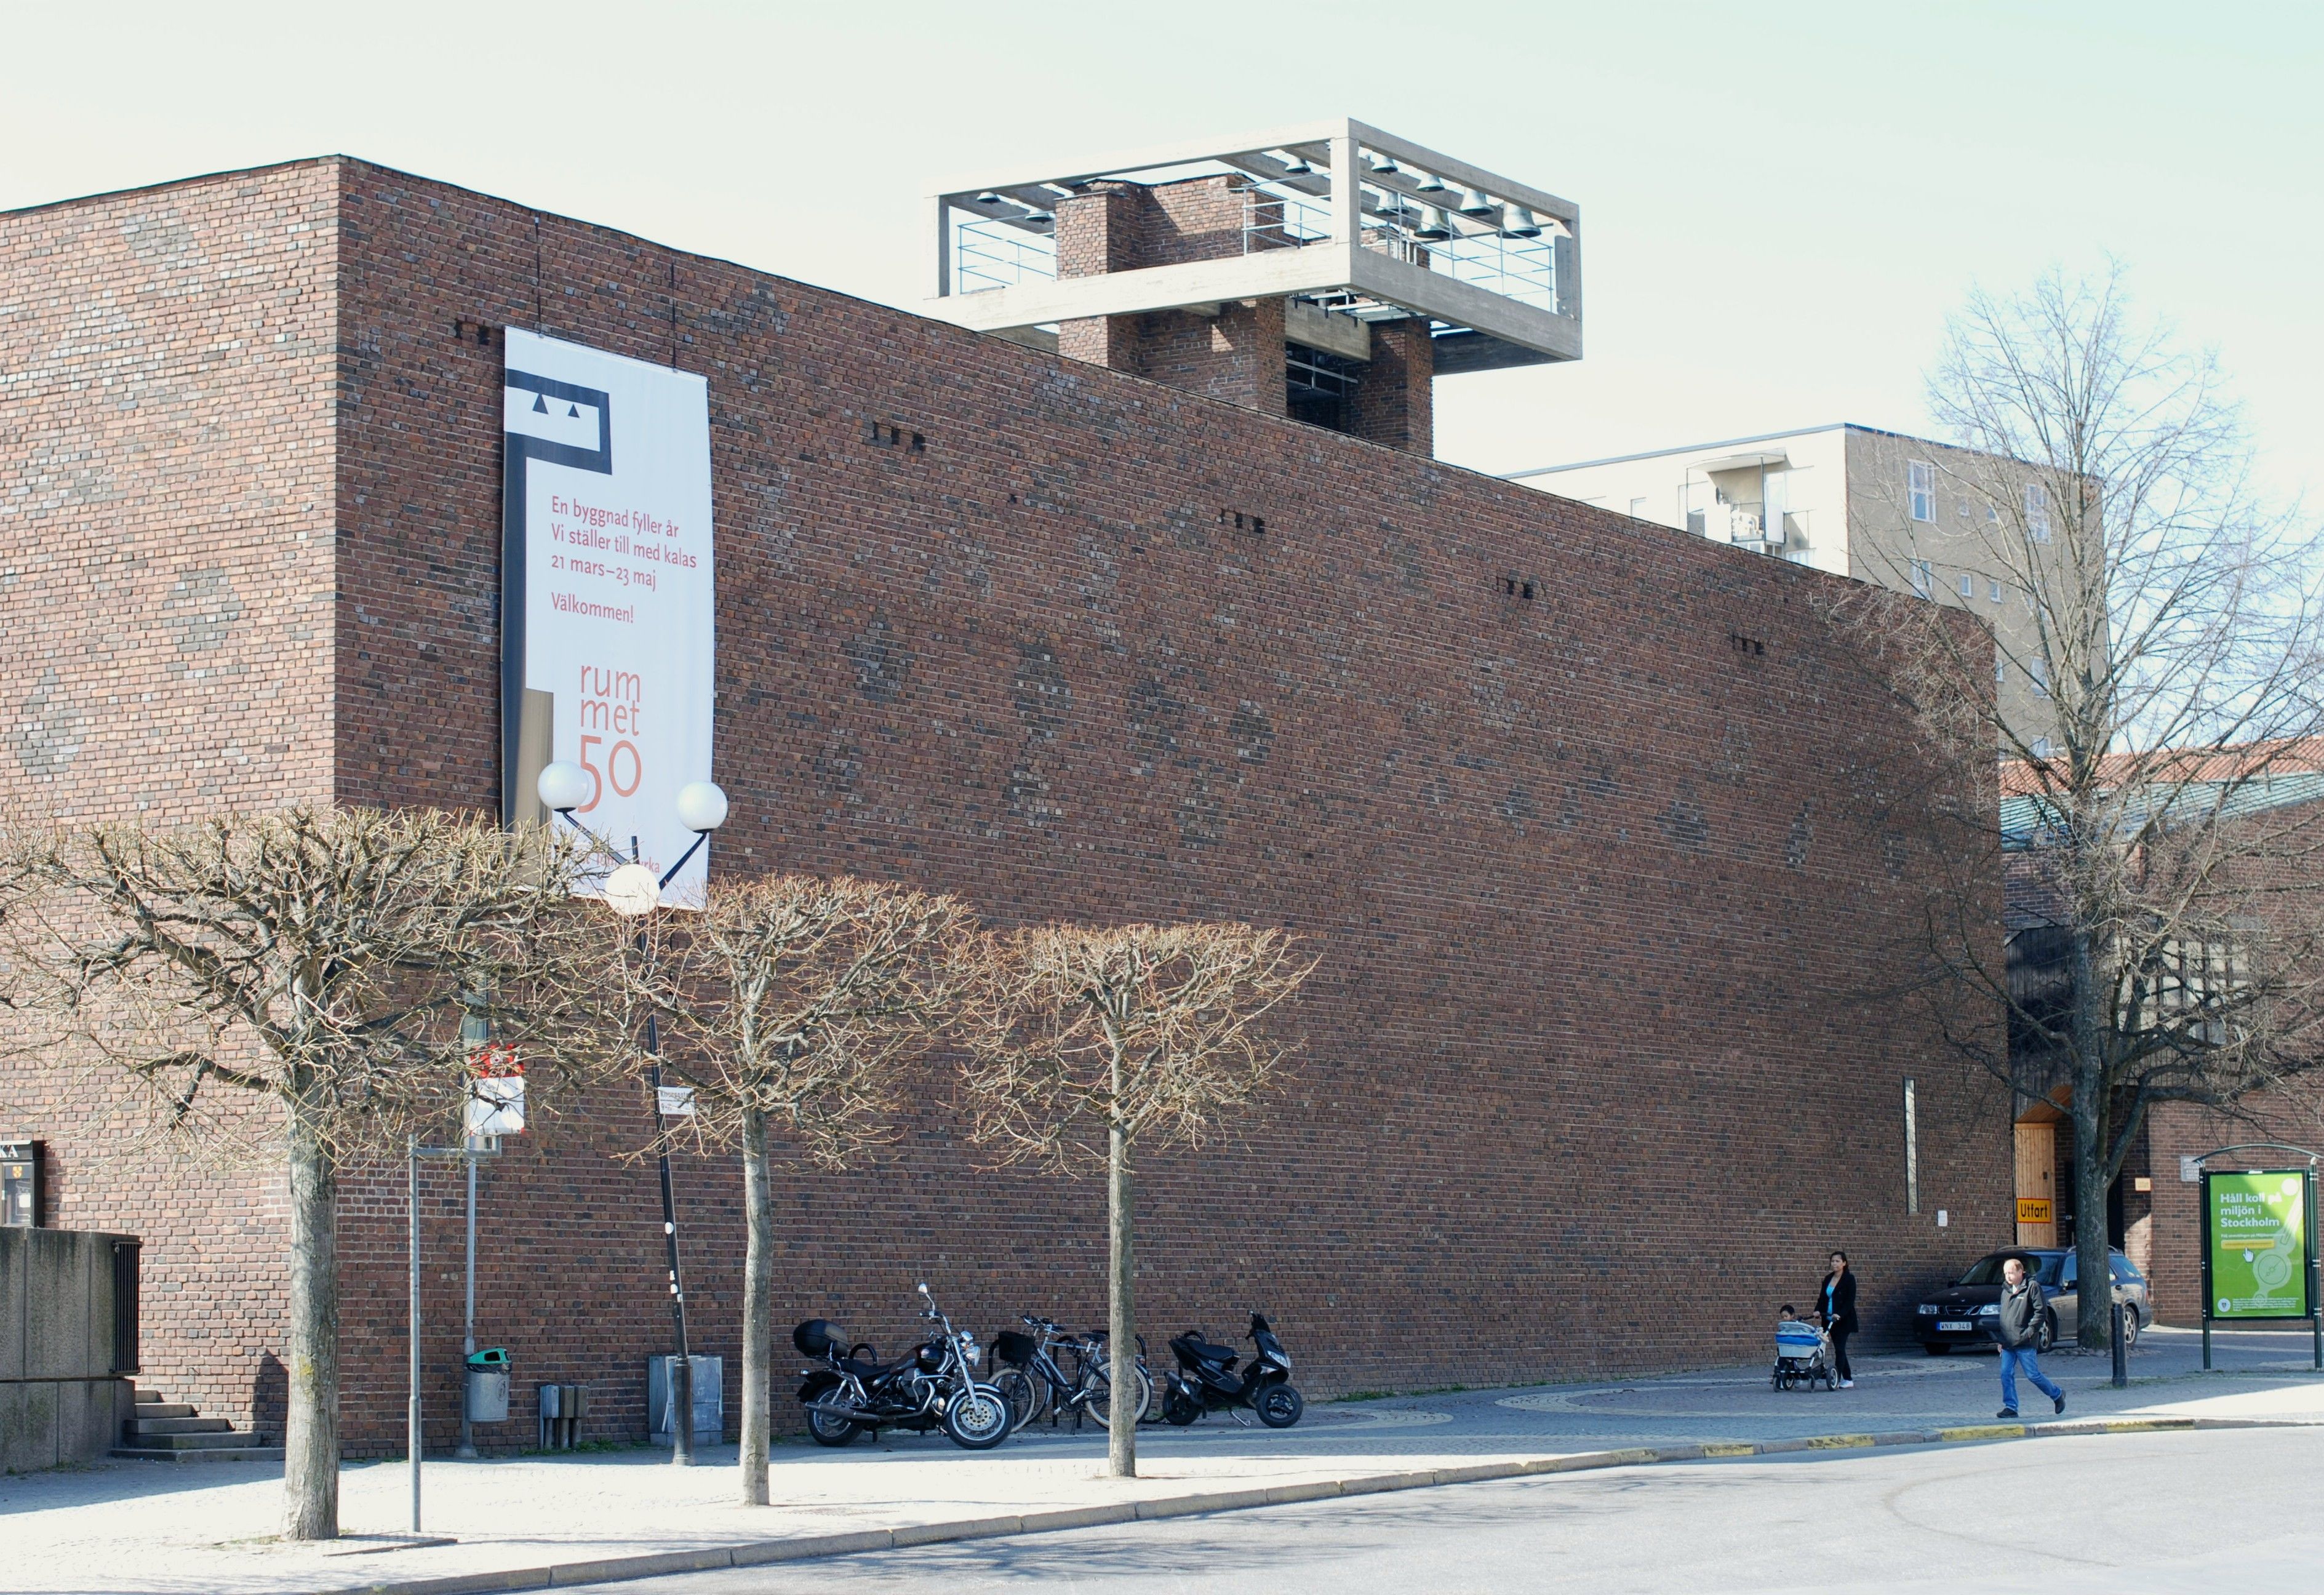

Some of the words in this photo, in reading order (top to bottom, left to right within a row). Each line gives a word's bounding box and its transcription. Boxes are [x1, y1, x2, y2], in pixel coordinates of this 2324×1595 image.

[552, 495, 568, 515] En
[573, 498, 628, 527] byggnad
[633, 511, 662, 535] fyller
[666, 519, 679, 538] år
[551, 523, 564, 542] Vi
[569, 529, 611, 550] ställer
[614, 535, 629, 554] till
[634, 543, 660, 561] med
[665, 545, 697, 568] kalas
[551, 555, 564, 569] 21
[633, 569, 656, 592] maj
[551, 592, 634, 623] Välkommen!
[581, 665, 641, 703] rum
[581, 699, 640, 736] met
[578, 734, 642, 813] 50
[2020, 1203, 2048, 1217] Utfart
[2220, 1193, 2243, 1203] Håll
[2245, 1191, 2265, 1202] koll
[2220, 1205, 2255, 1217] miljön
[2258, 1205, 2261, 1215] i
[2221, 1217, 2280, 1228] Stockholm
